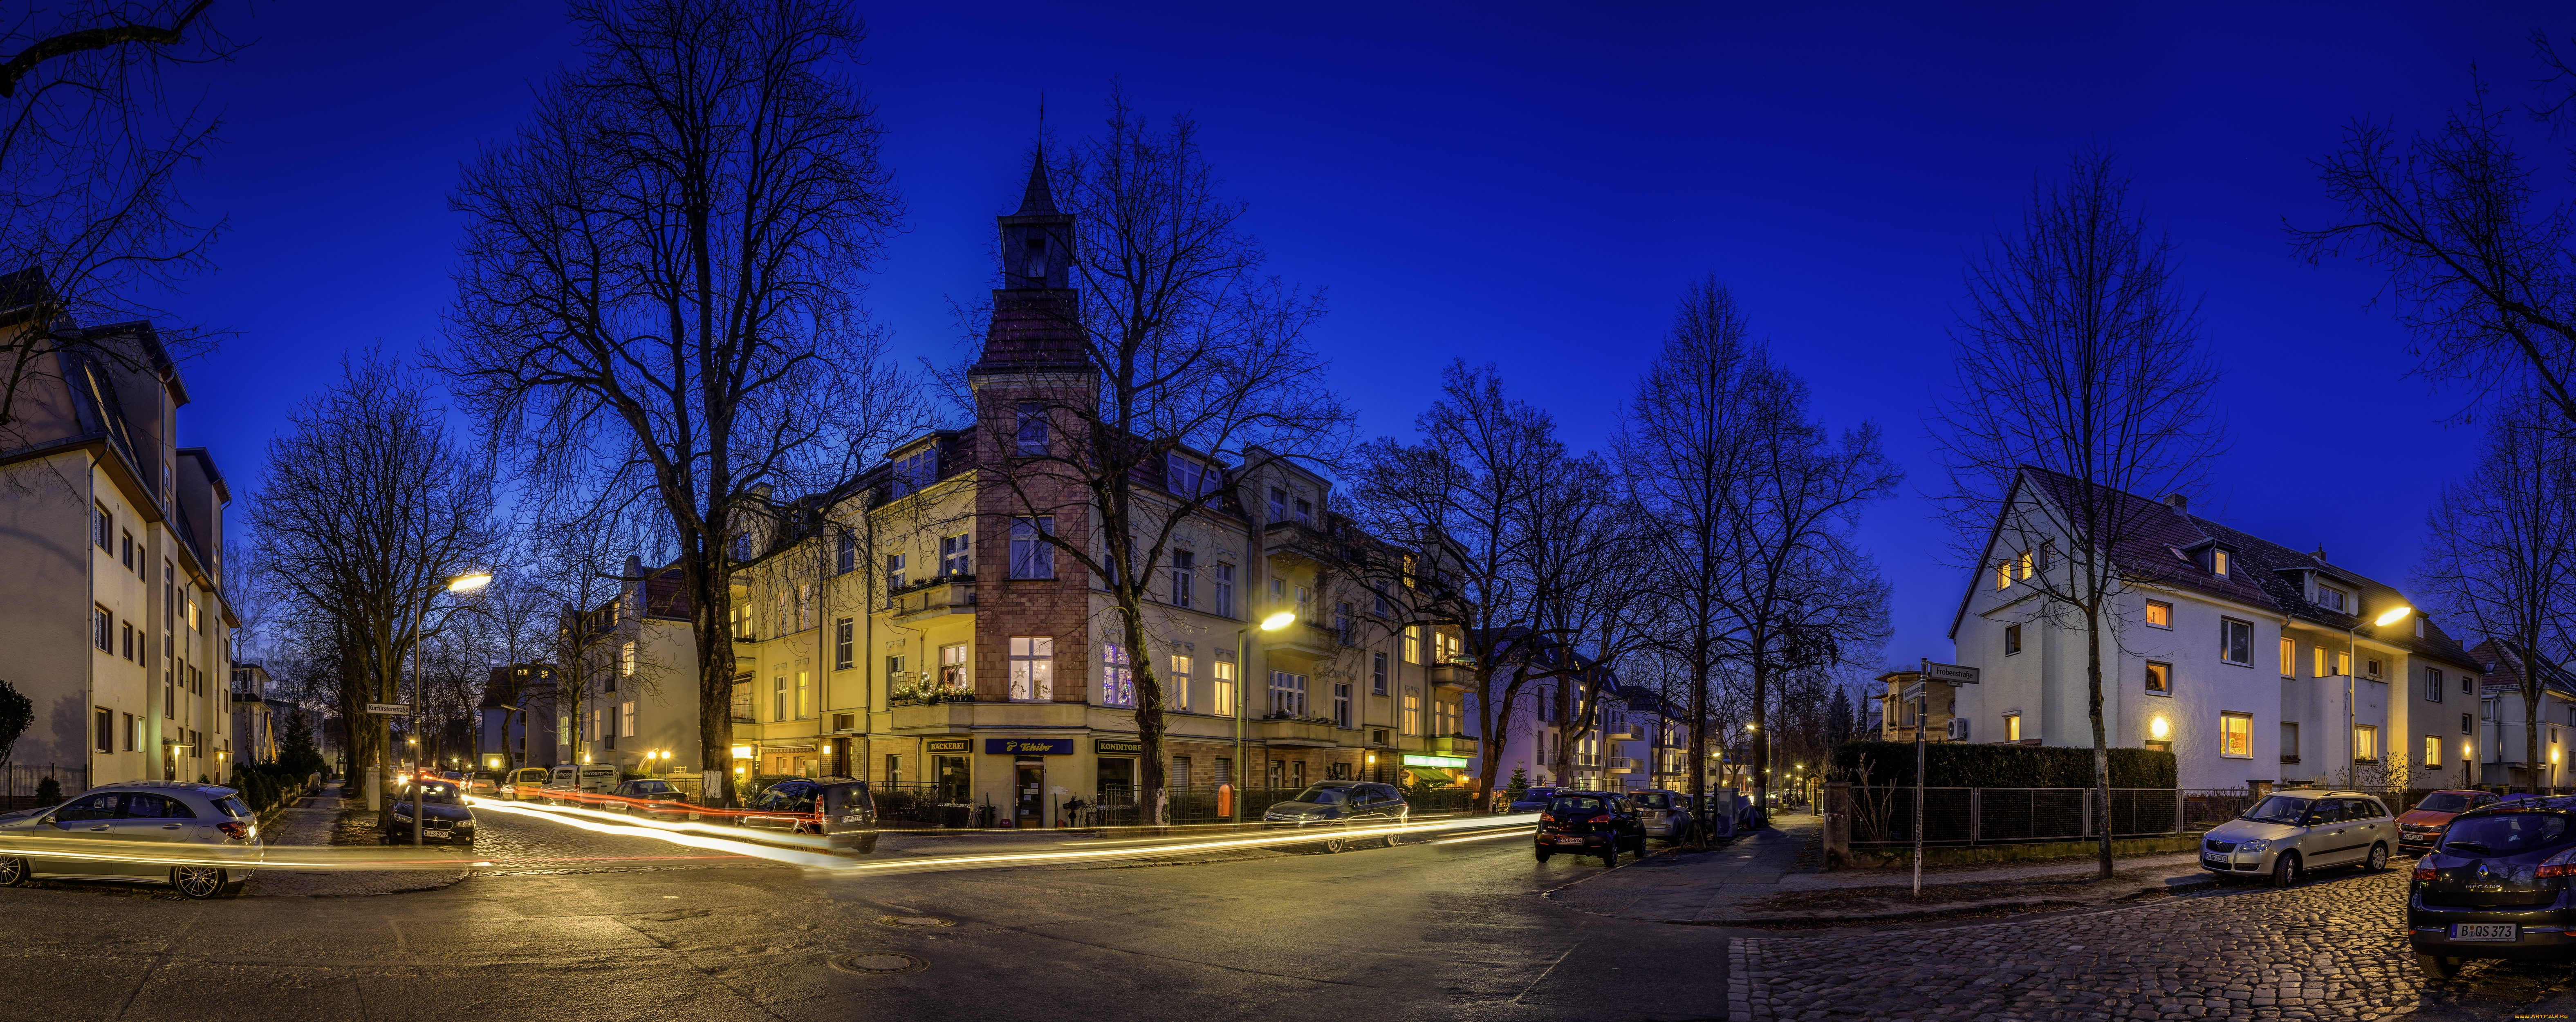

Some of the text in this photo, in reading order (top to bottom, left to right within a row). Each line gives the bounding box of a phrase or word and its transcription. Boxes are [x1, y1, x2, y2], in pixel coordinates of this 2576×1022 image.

[1936, 667, 1973, 679] Frobenstraße
[369, 705, 408, 713] Kurfürstenstraße
[1020, 743, 1054, 751] Tchibo
[1100, 743, 1141, 751] KONDITORE
[2461, 926, 2512, 937] B QS 373
